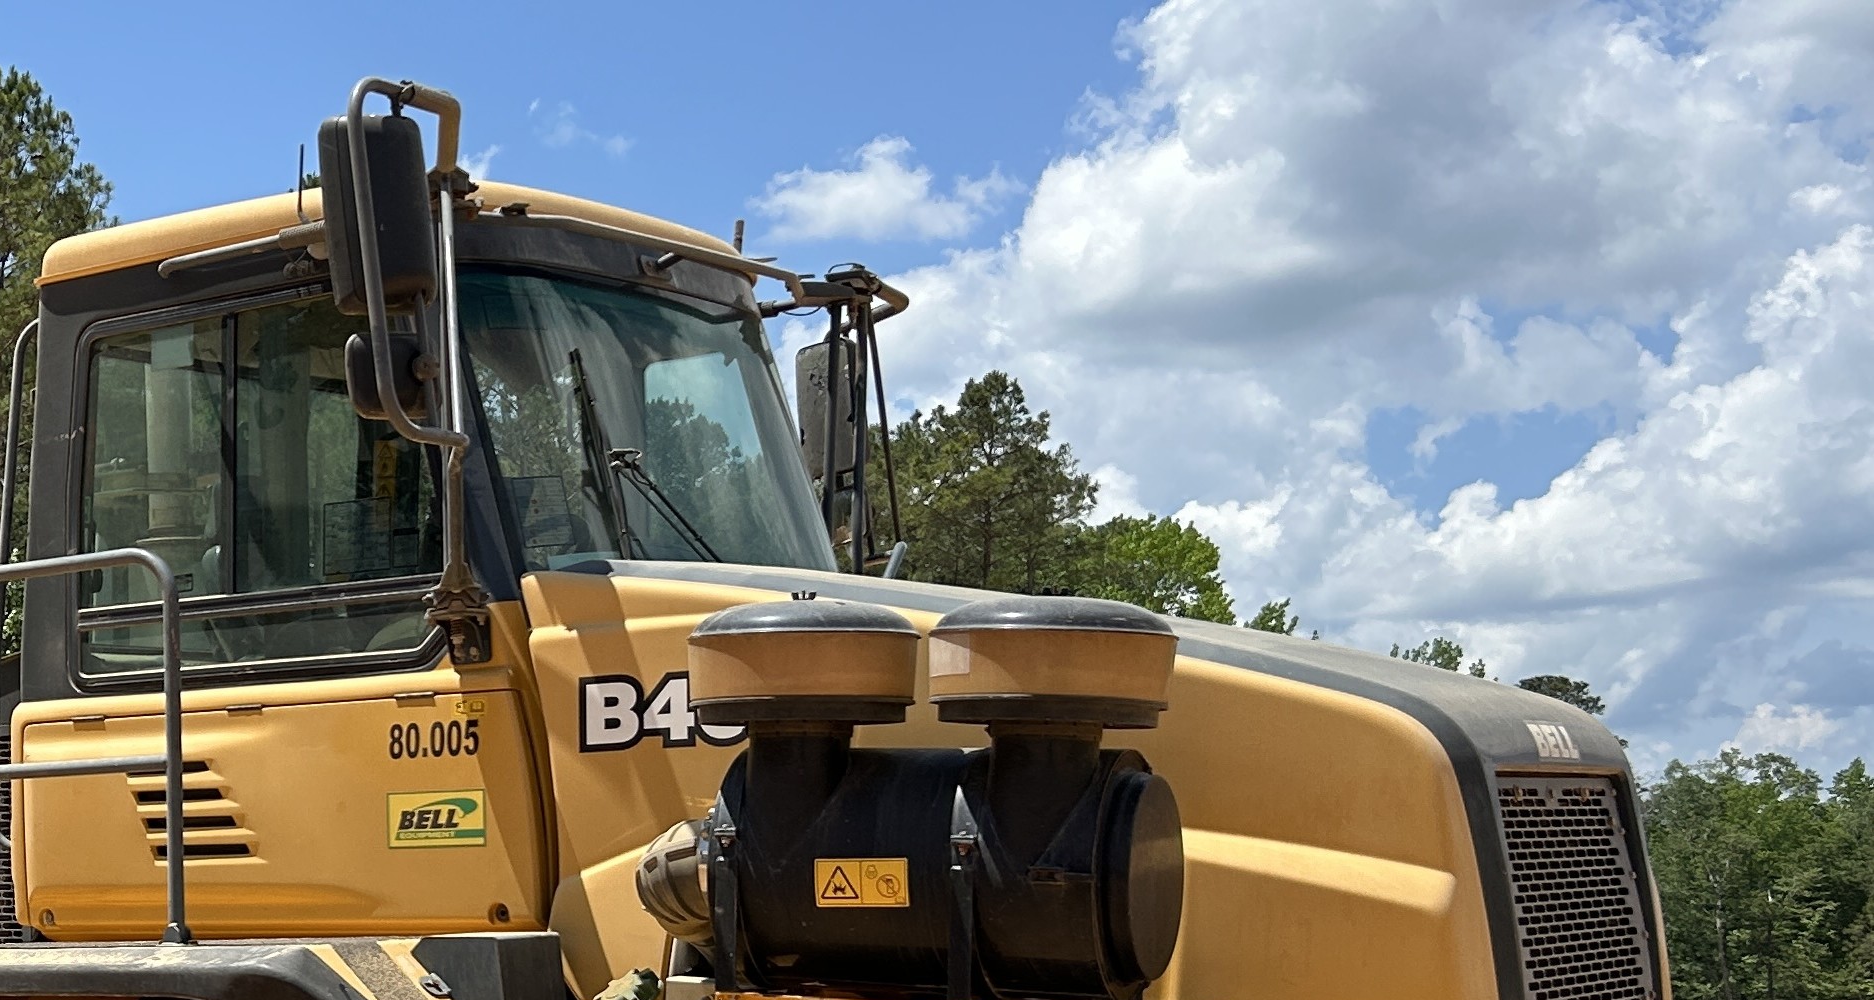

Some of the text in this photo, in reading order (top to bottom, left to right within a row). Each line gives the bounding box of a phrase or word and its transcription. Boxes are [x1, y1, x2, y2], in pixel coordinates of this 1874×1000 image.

[579, 671, 748, 753] B4
[388, 719, 480, 759] 80.005
[1526, 723, 1580, 759] BELL
[398, 808, 460, 831] BELL
